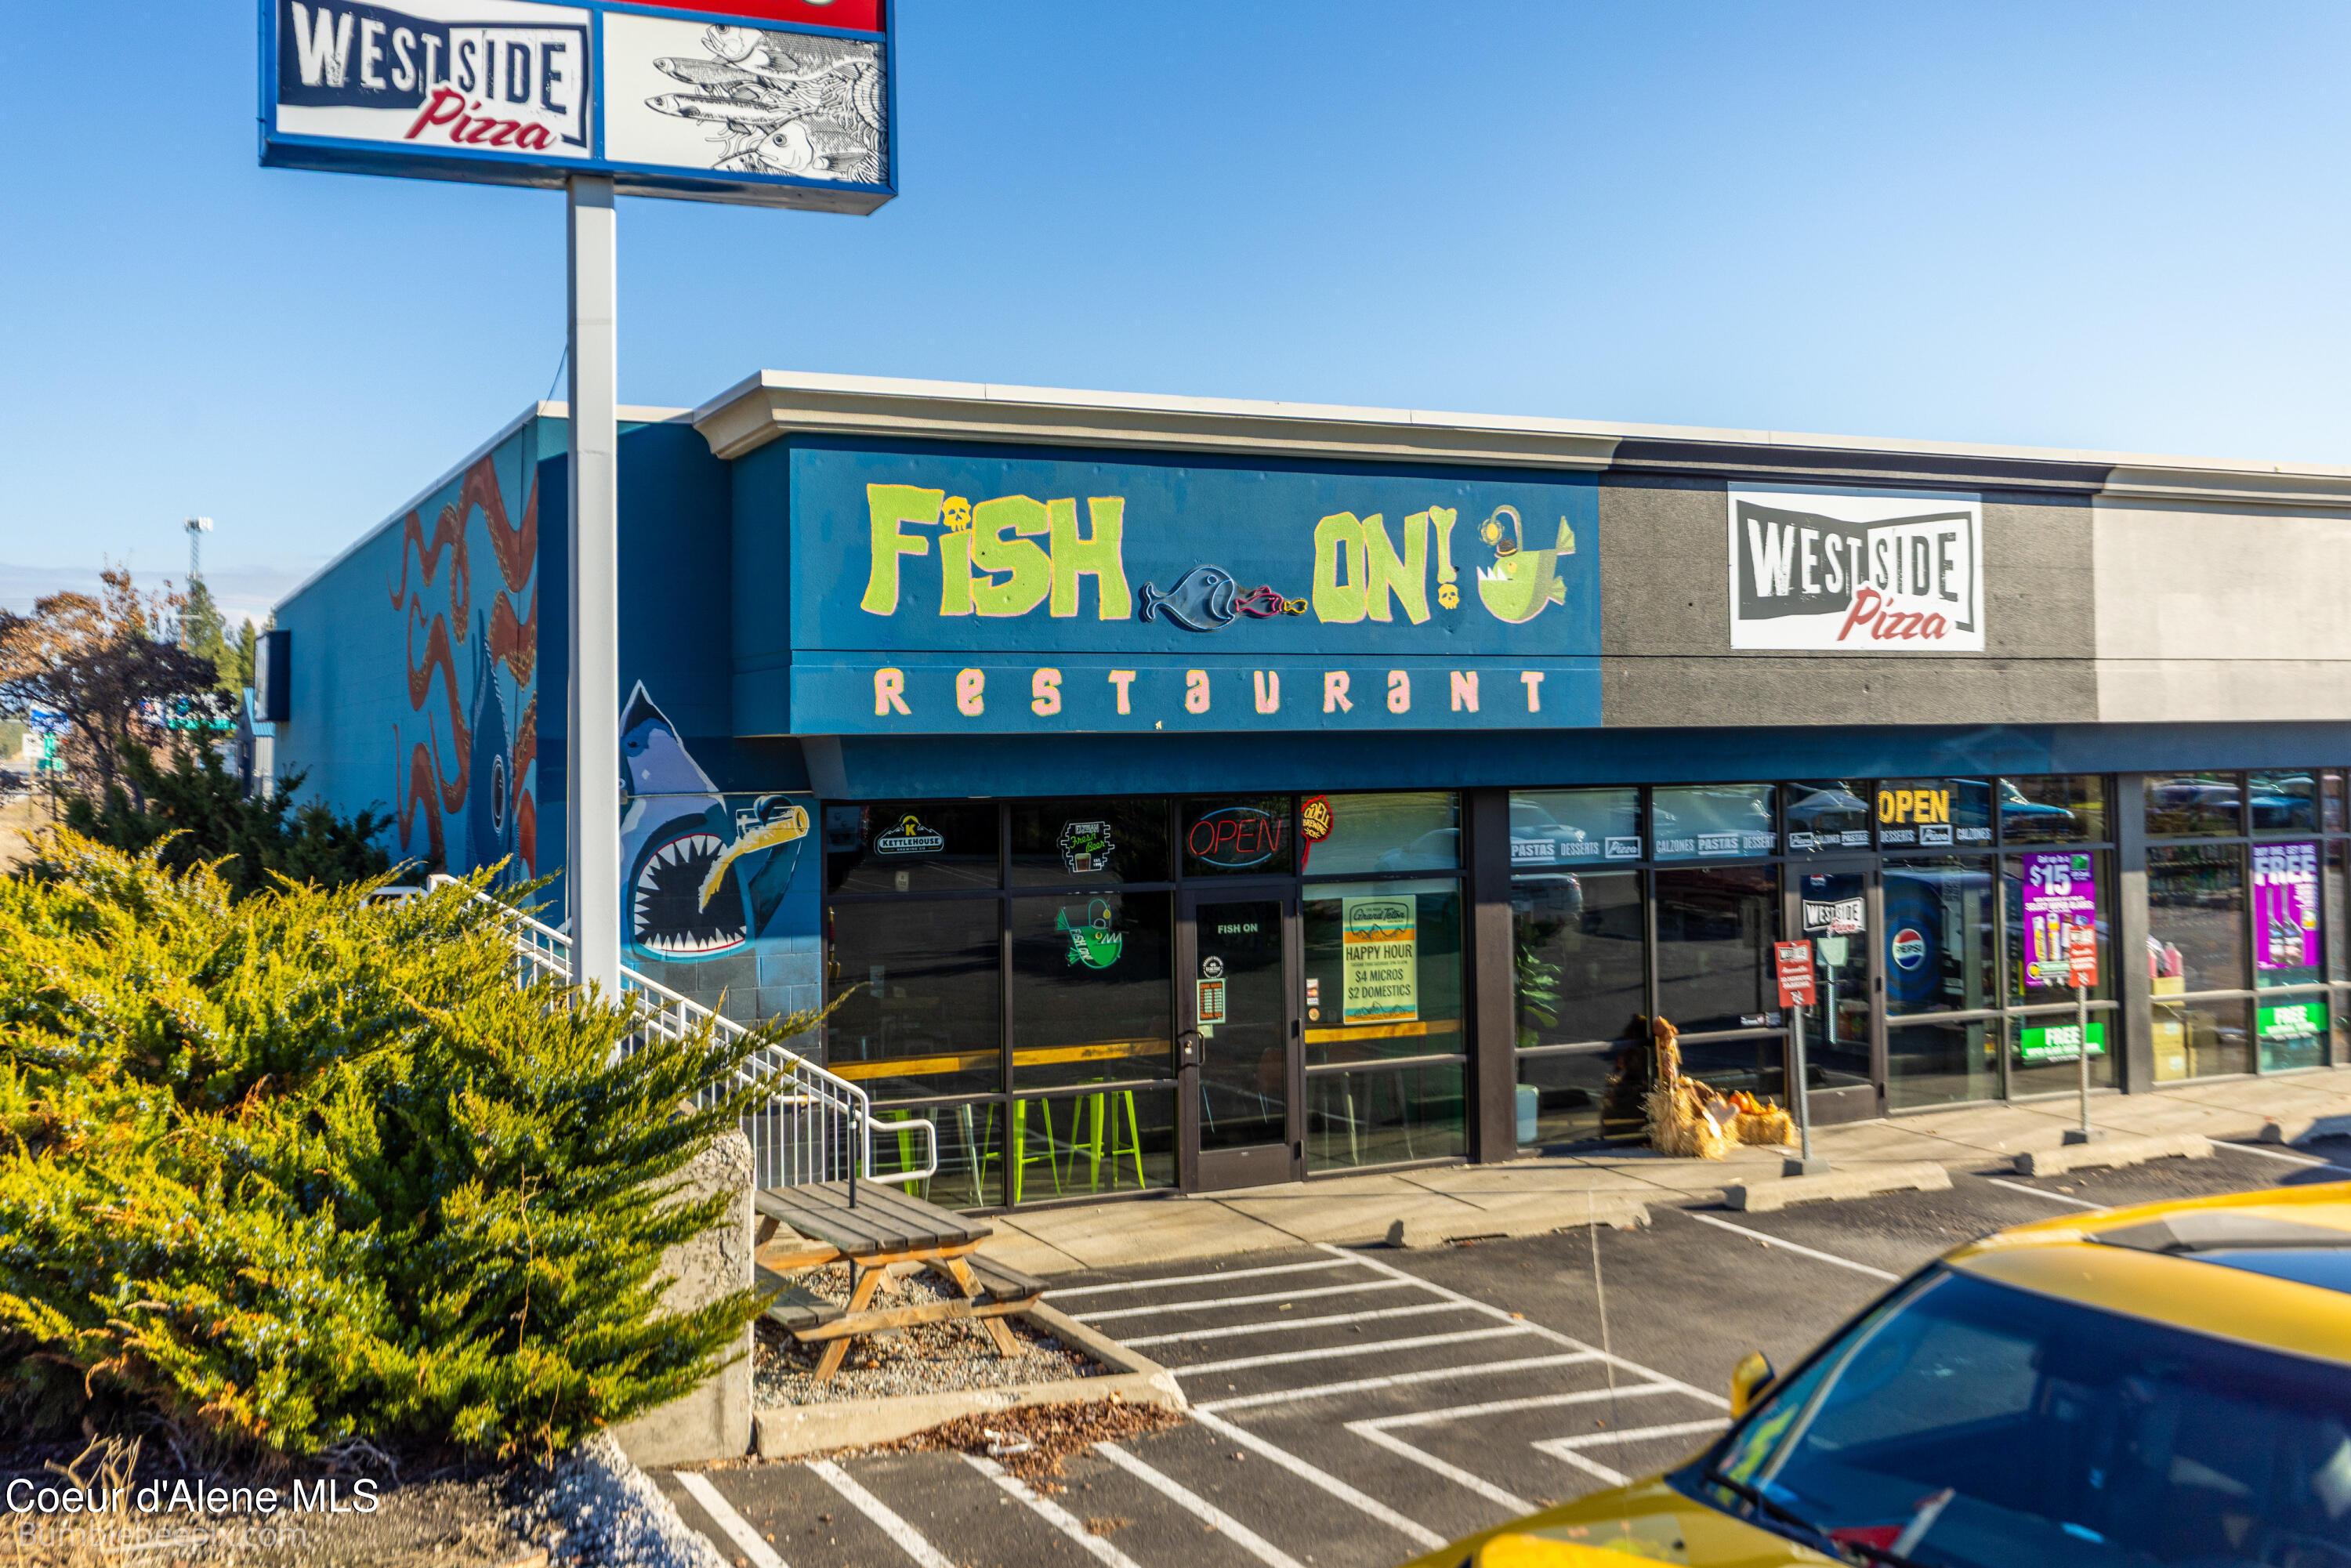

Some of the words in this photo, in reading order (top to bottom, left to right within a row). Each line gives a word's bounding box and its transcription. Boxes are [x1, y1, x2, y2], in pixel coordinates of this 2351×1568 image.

[404, 85, 556, 150] Pizza
[1837, 586, 1951, 642] Pizza
[1878, 789, 1950, 824] OPEN
[905, 824, 917, 836] K
[1189, 817, 1281, 856] OPEN
[882, 838, 940, 847] KETTLEHOUSE
[1070, 832, 1096, 849] Fresh
[1085, 839, 1106, 853] Beer
[1511, 844, 1555, 856] PASTAS
[1560, 842, 1599, 856] DESSERTS
[1608, 840, 1638, 854] Pizza
[1656, 838, 1694, 853] CALZONES
[1698, 837, 1738, 850] PASTAS
[2029, 864, 2072, 896] $15
[1353, 908, 1384, 921] Grand
[1217, 924, 1241, 935] FISH
[1243, 923, 1259, 933] ON
[1346, 945, 1380, 961] HAPPY
[1384, 943, 1413, 959] HOUR
[1355, 970, 1367, 983] $4
[1369, 969, 1404, 982] MICROS
[1348, 987, 1360, 1000] $2
[1361, 984, 1411, 998] DOMESTICS
